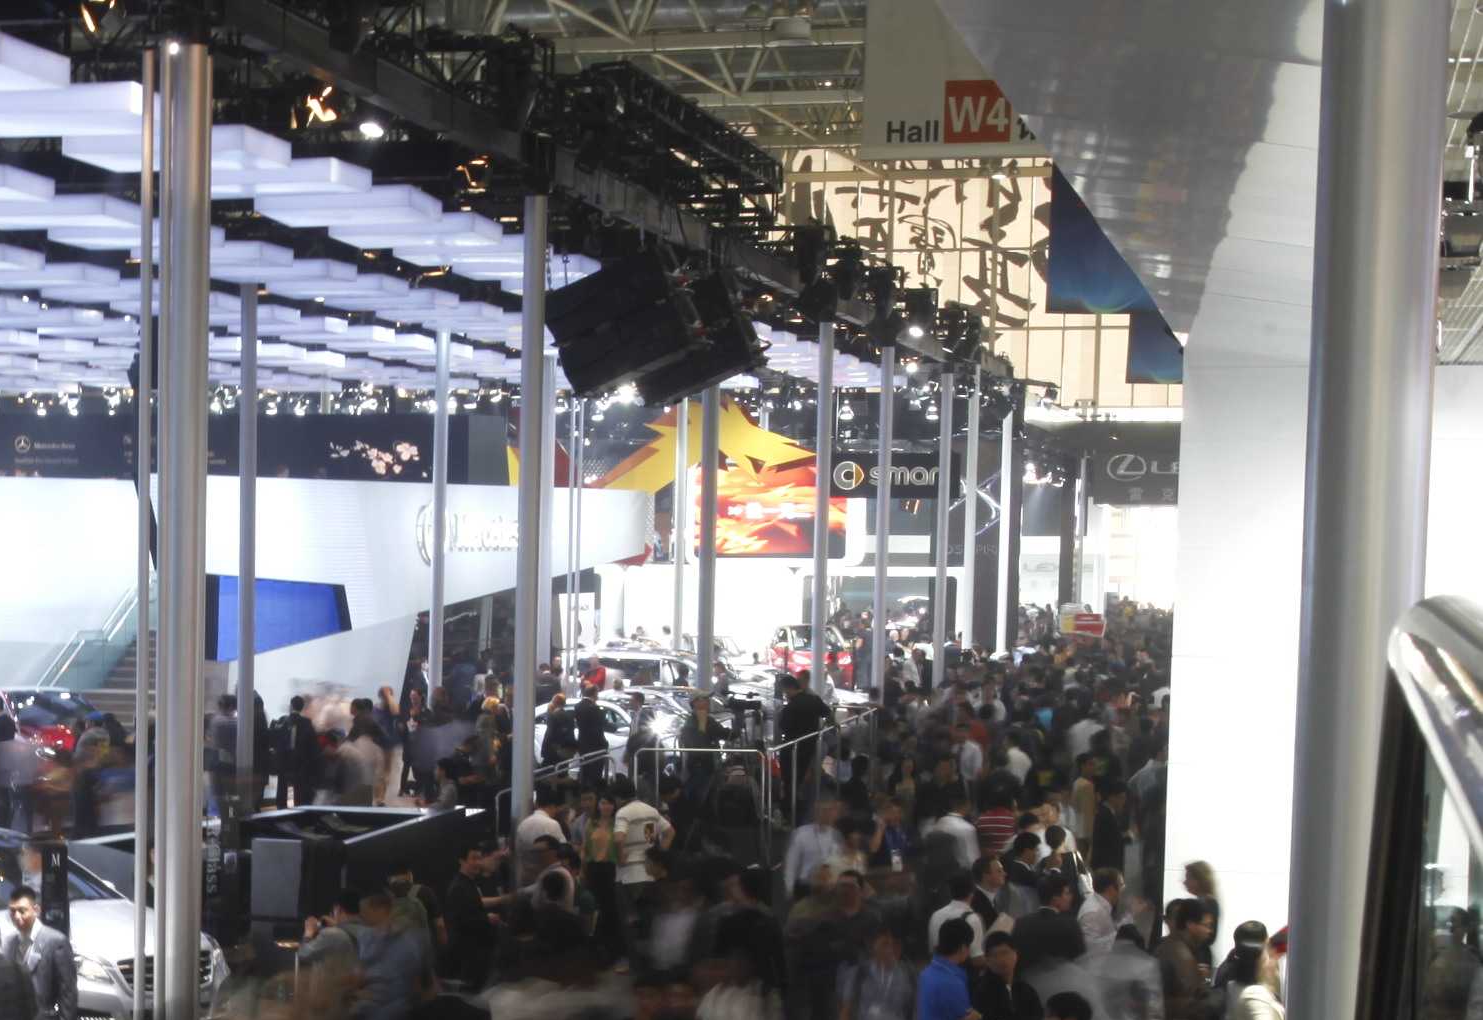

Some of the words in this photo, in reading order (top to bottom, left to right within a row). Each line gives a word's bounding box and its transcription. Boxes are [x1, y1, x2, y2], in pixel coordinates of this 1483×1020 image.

[886, 120, 939, 143] Hall
[948, 96, 1009, 133] W4
[869, 466, 941, 486] smar
